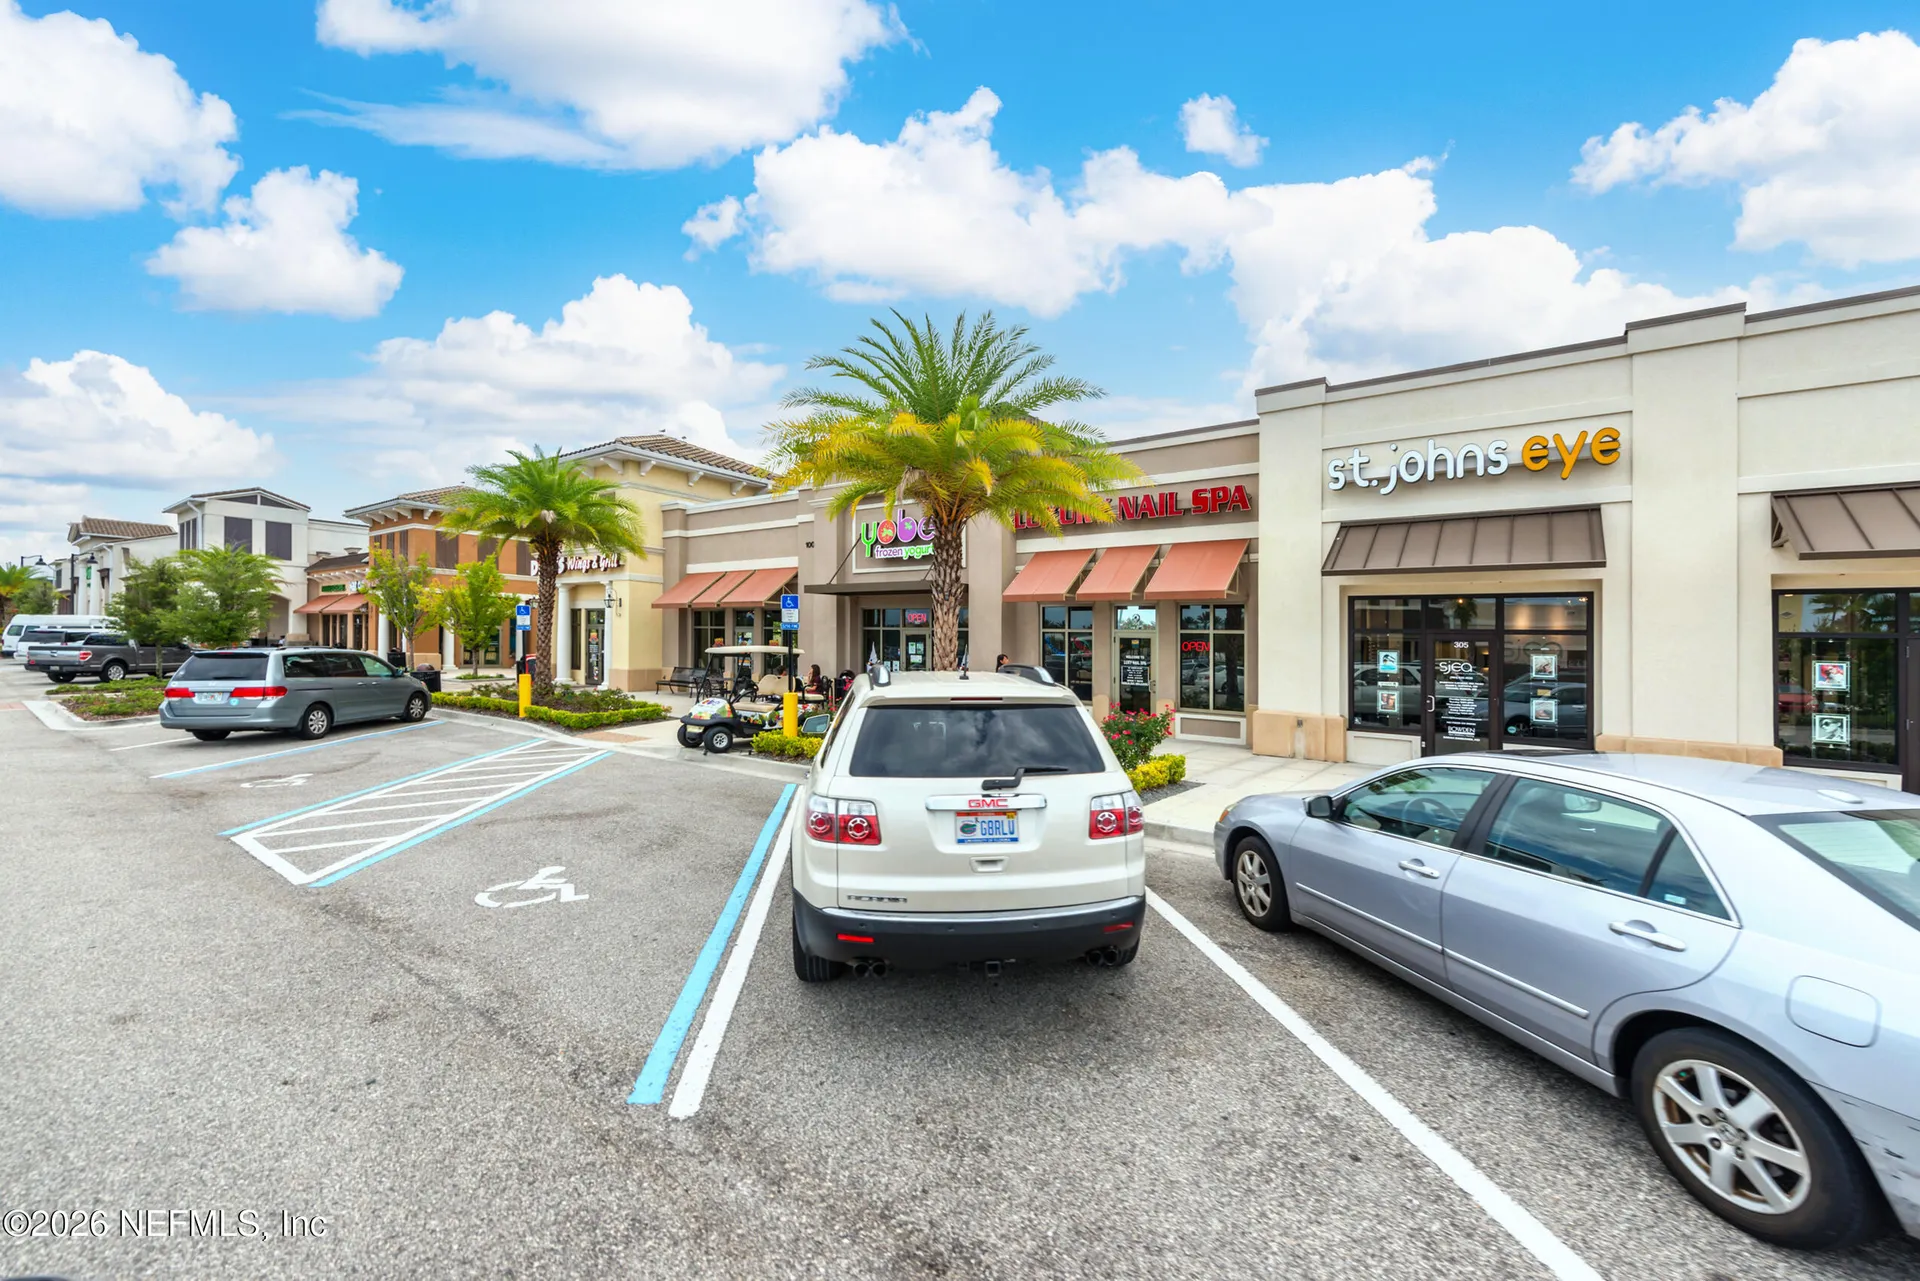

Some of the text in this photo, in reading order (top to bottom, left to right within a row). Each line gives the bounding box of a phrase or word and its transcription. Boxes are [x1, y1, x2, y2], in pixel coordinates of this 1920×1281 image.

[1521, 427, 1621, 480] eye
[1117, 491, 1184, 521] NAIL
[1191, 484, 1251, 515] SPA
[875, 545, 903, 558] frozen
[567, 555, 591, 574] Wings
[591, 555, 599, 569] &
[599, 552, 618, 572] Grill
[907, 613, 927, 622] OPEN
[1181, 641, 1211, 652] OPEN
[1453, 641, 1469, 649] 305
[1439, 661, 1473, 675] sjea
[968, 799, 1008, 809] GMC
